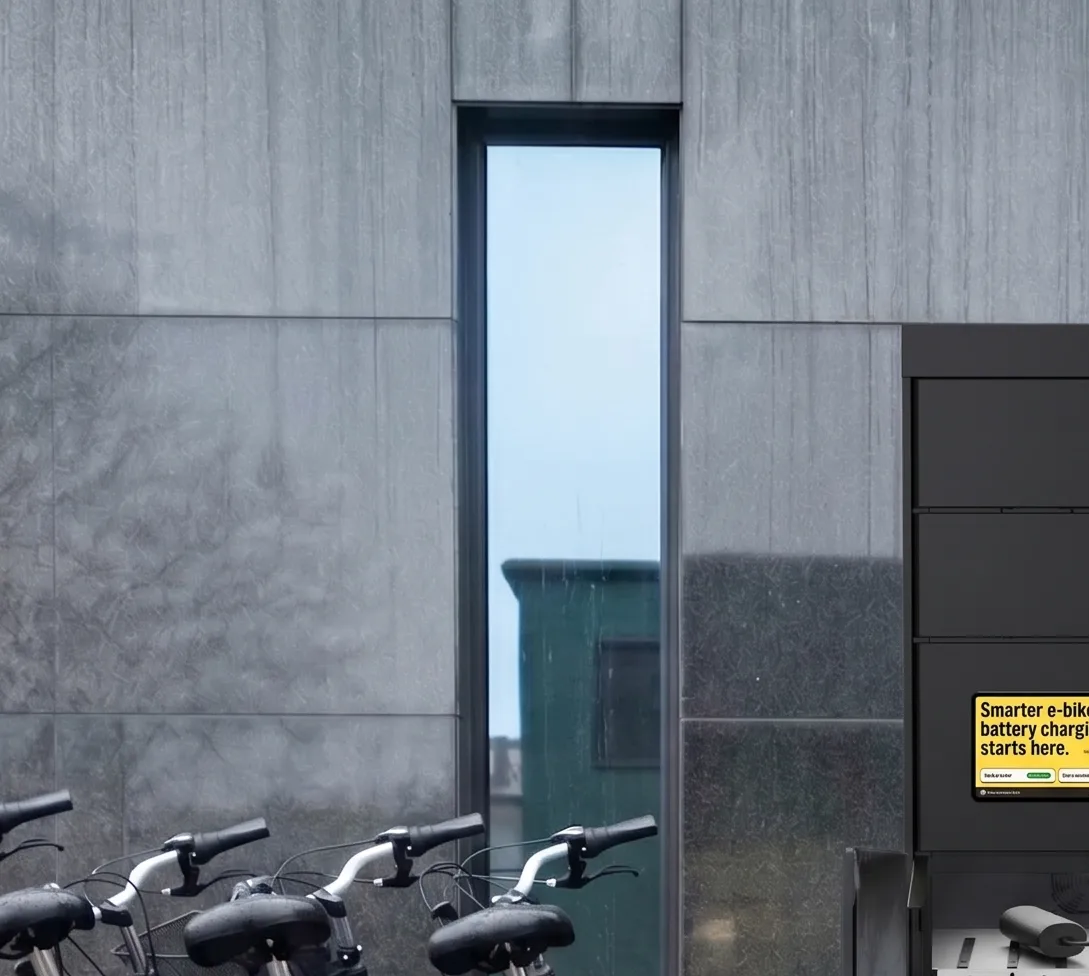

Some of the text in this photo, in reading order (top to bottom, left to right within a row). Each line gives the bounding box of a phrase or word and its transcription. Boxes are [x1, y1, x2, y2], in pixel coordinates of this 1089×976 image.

[981, 702, 1043, 717] Smarter
[981, 721, 1037, 740] battery
[981, 741, 1026, 755] starts
[1031, 740, 1069, 755] here.
